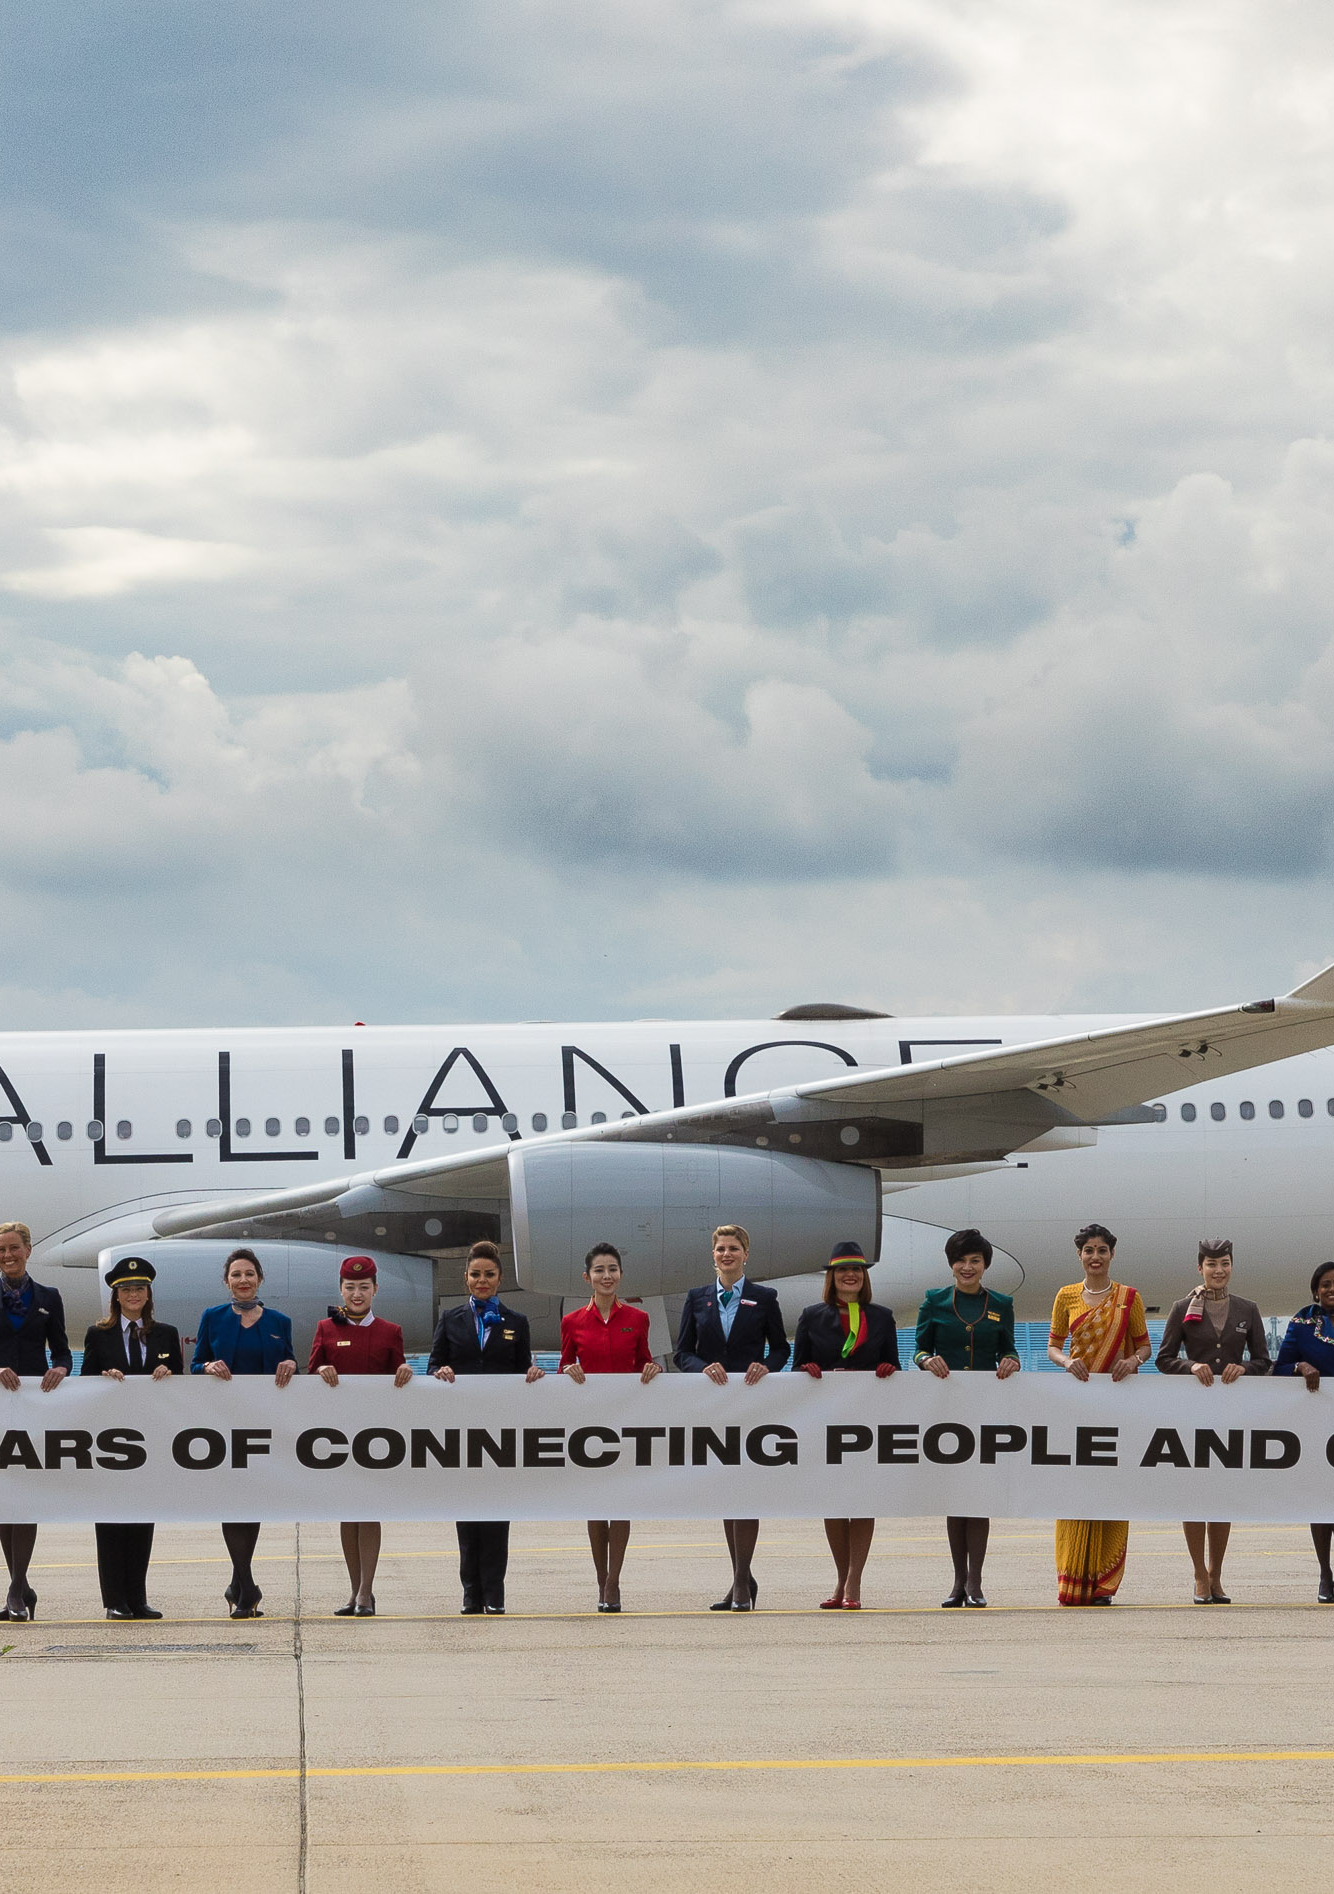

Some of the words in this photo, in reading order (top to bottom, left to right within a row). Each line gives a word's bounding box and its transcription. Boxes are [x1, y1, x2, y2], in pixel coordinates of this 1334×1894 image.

[171, 1427, 272, 1470] OF
[295, 1424, 798, 1470] CONNECTING
[826, 1422, 1119, 1467] PEOPLE
[1139, 1428, 1301, 1470] AND
